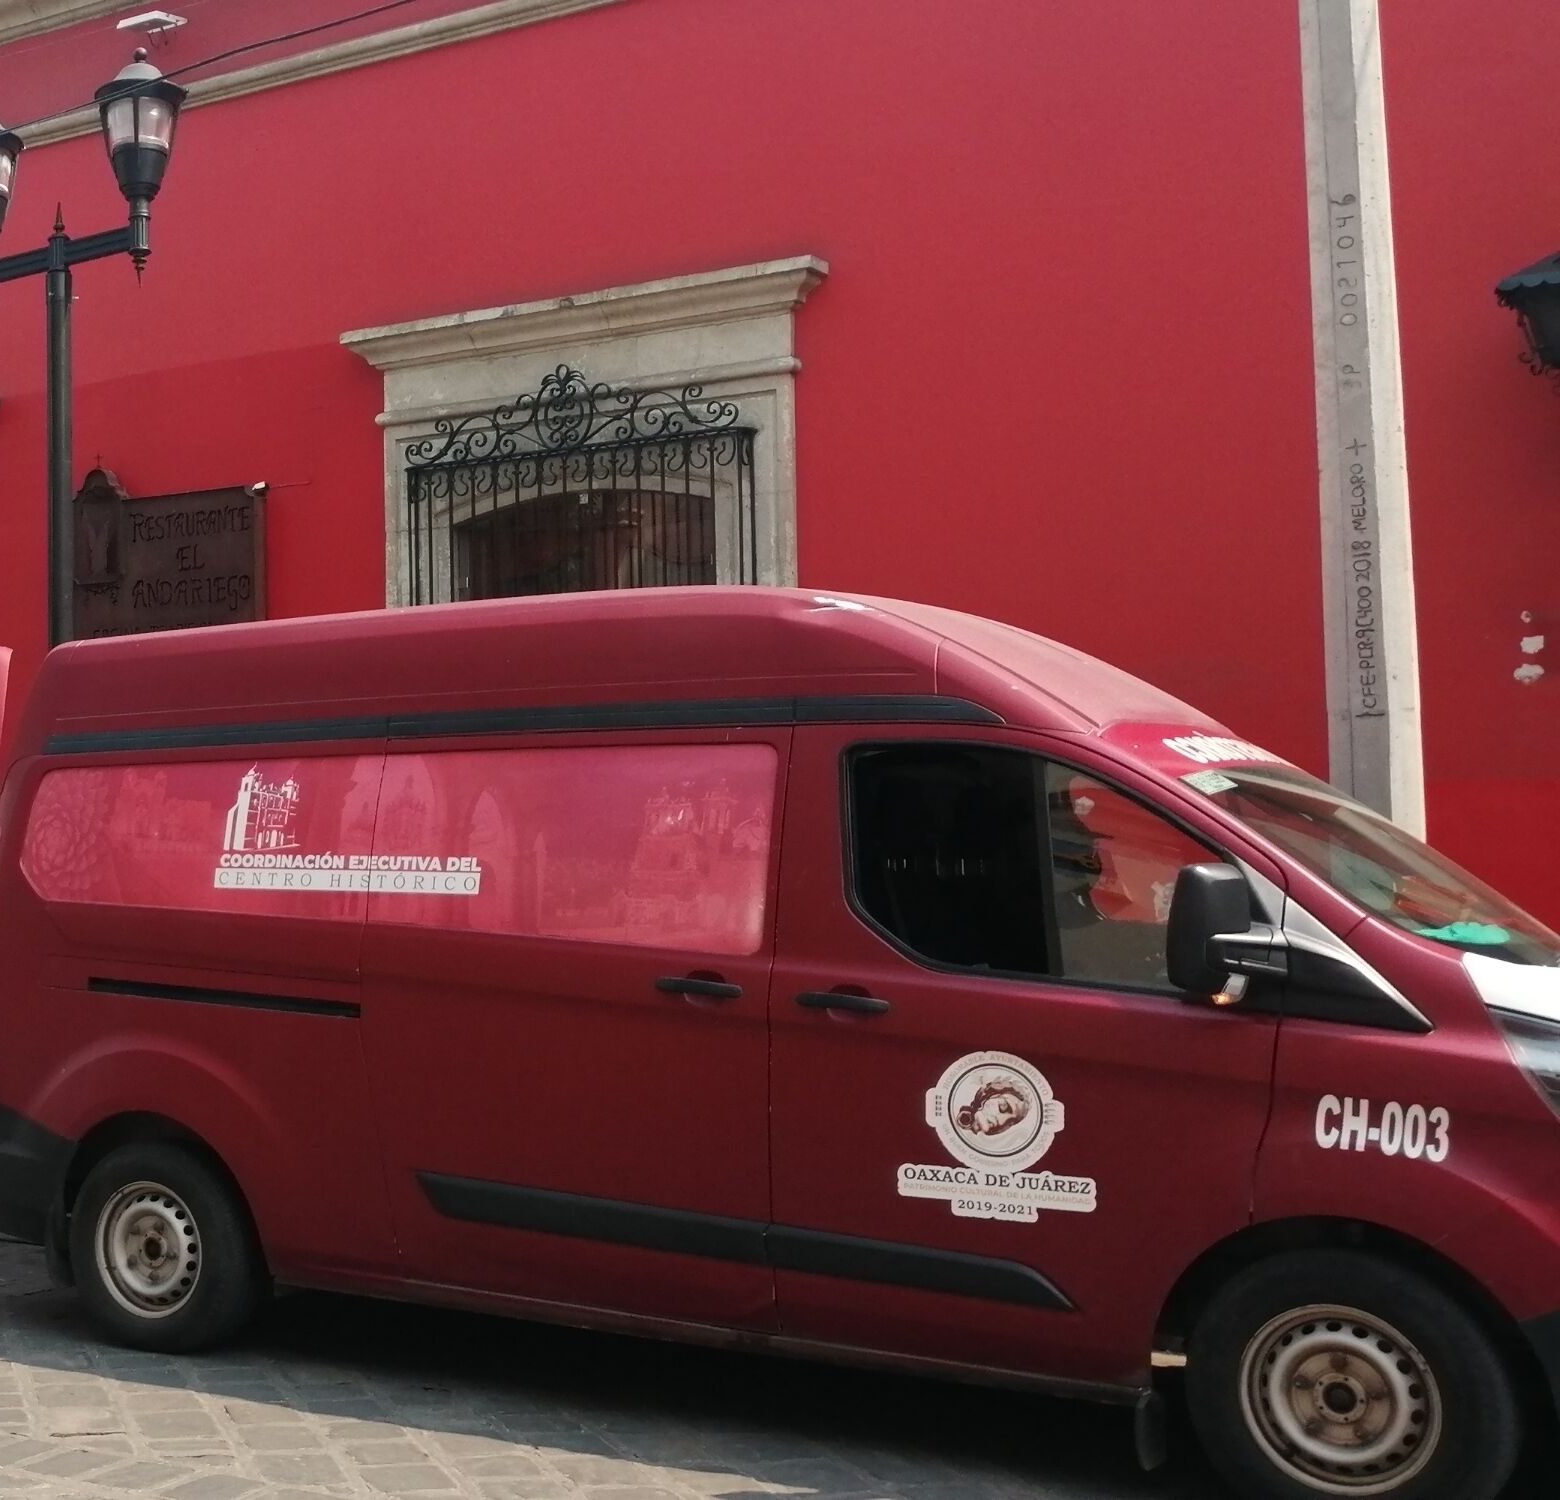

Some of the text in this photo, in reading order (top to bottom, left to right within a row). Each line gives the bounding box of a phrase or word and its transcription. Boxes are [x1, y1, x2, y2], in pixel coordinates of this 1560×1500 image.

[1330, 194, 1358, 326] 0021046
[130, 505, 251, 543] RESTAURANTE
[176, 543, 206, 571] EL
[1351, 541, 1372, 582] 2018
[131, 574, 251, 611] ANDARIEGO
[220, 851, 481, 872] COORDINACIÓN EJECUTIVA DEL
[219, 872, 477, 891] CENTRO HISTÓRICO
[1316, 1094, 1449, 1162] CH-003
[904, 1167, 1092, 1195] OAXACA DE JUÁREZ
[958, 1199, 1033, 1215] 2019-2021
